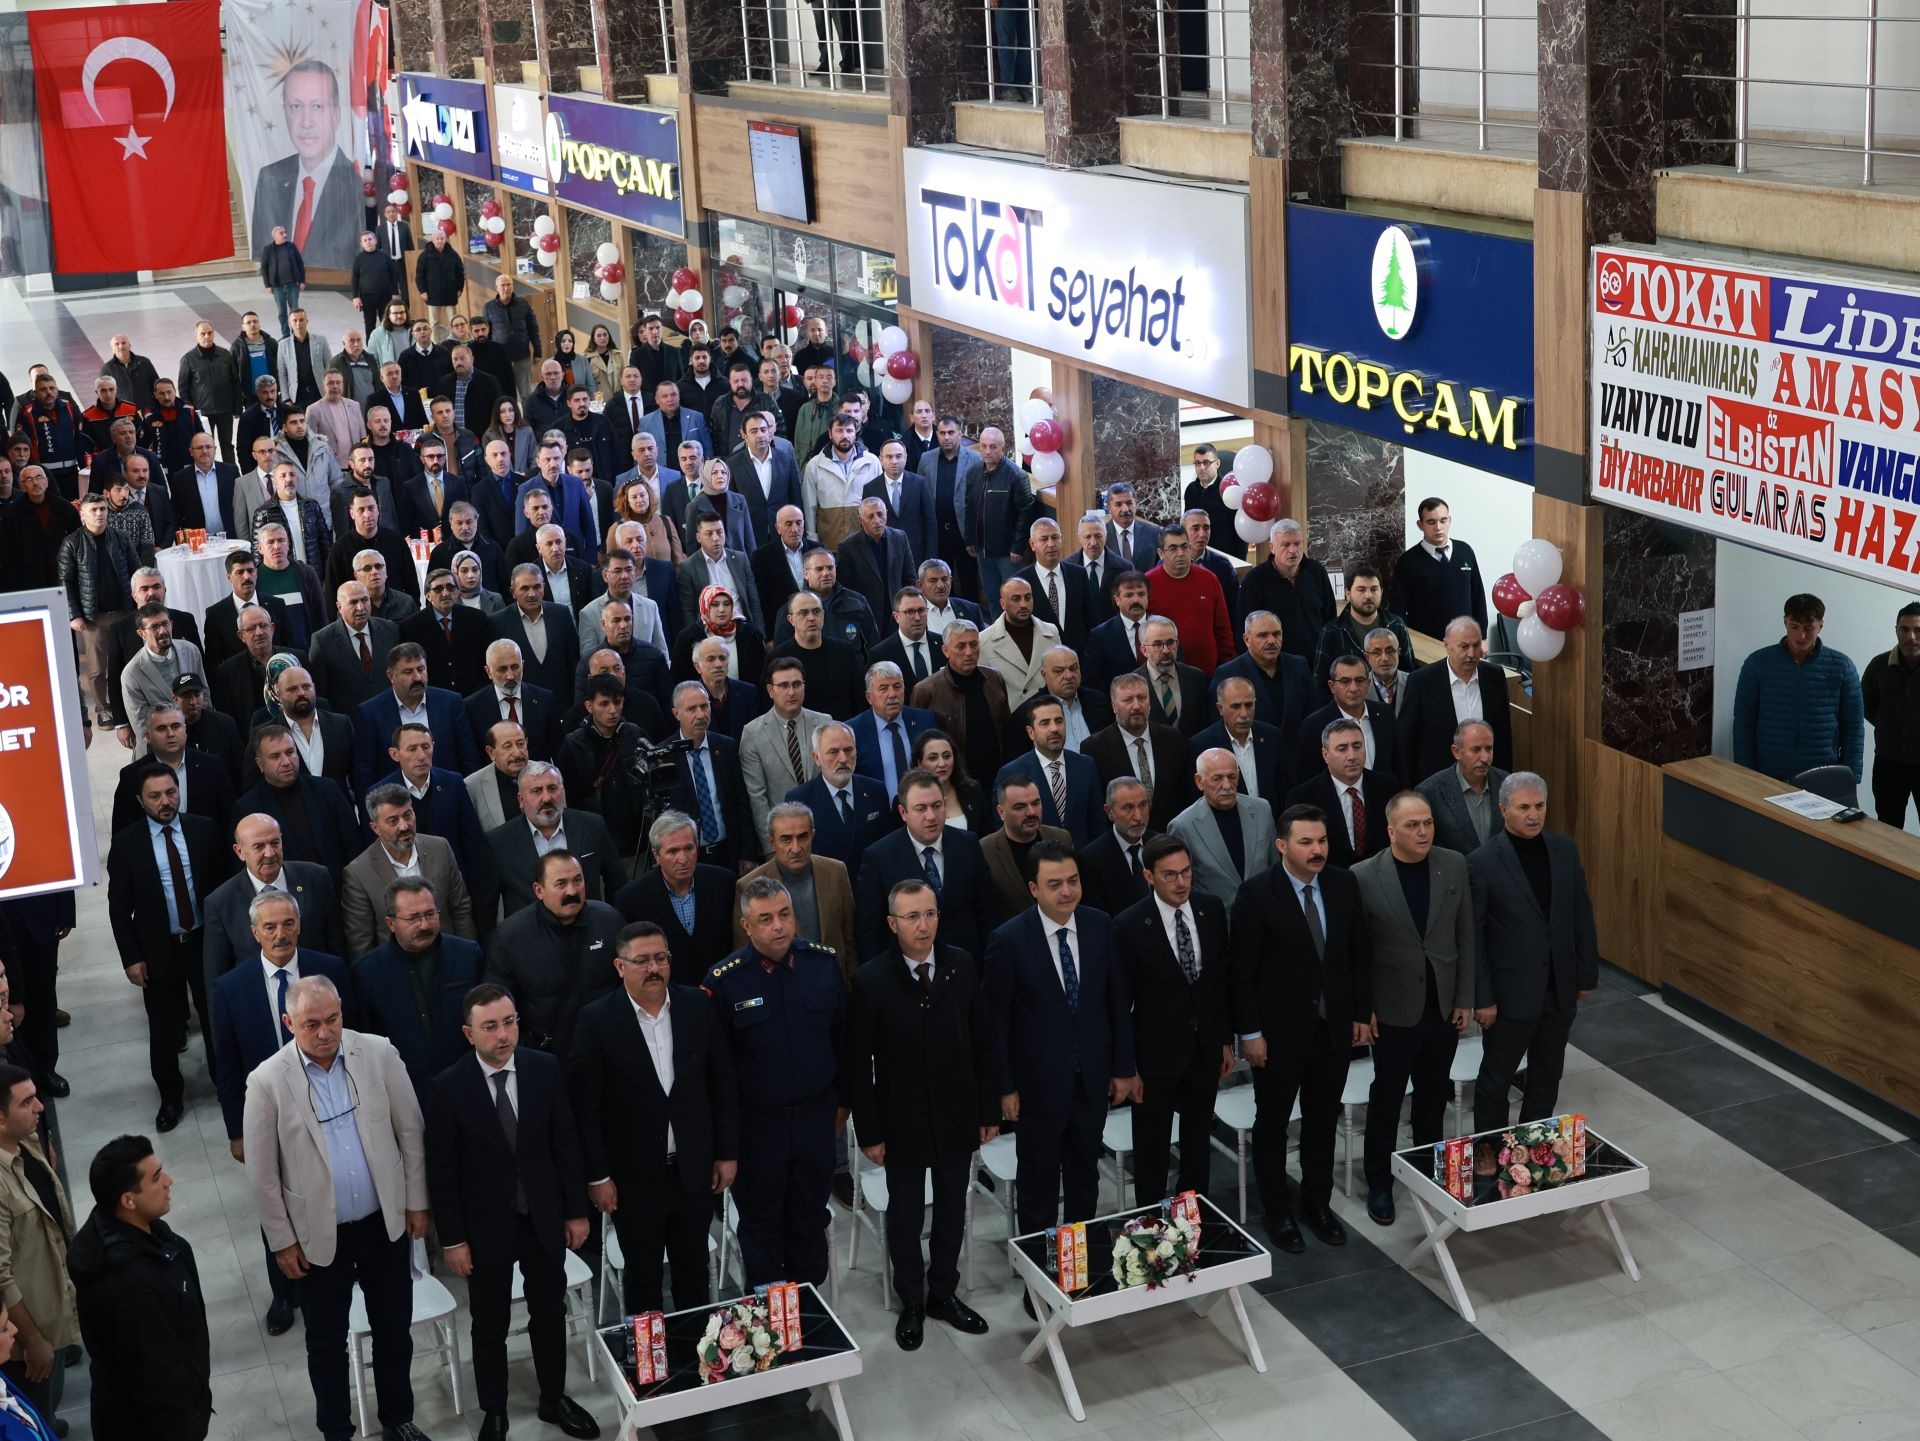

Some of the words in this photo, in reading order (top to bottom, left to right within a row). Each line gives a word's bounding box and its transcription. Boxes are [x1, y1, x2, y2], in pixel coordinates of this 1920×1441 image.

[562, 141, 674, 200] TOPÇAM
[1048, 266, 1185, 351] seyahat
[1626, 262, 1761, 336] TOKAT
[1290, 346, 1517, 450] TOPÇAM
[1601, 382, 1702, 448] VANYOLU
[1767, 410, 1777, 429] ÖZ
[1599, 438, 1704, 513] DİYARBAKIR
[1709, 398, 1831, 485] ELBİSTAN
[0, 727, 36, 751] ET
